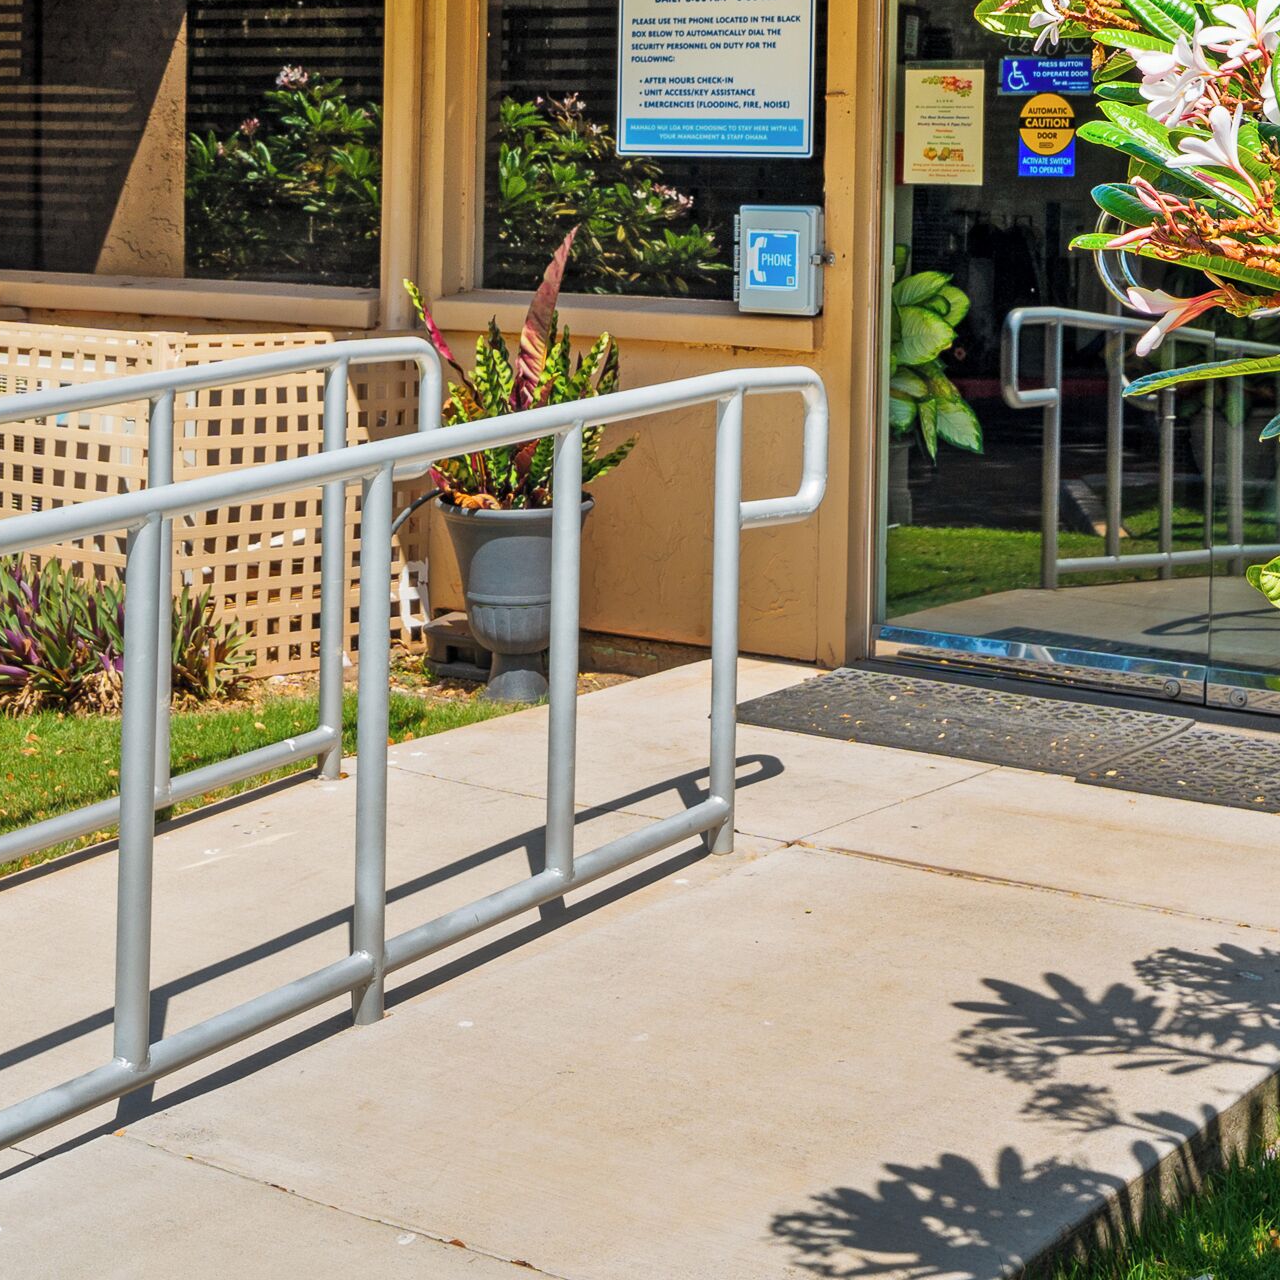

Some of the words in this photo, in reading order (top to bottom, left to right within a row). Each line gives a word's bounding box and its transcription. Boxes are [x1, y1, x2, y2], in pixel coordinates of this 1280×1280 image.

[658, 17, 671, 25] USE
[716, 16, 749, 24] LOCATED
[777, 15, 801, 23] BLACK
[686, 29, 746, 37] AUTOMATICALLY
[666, 42, 708, 50] PERSONNEL
[696, 101, 741, 109] (FLOODING,
[743, 101, 762, 109] FIRE,
[763, 101, 790, 109] NOISE)
[1025, 118, 1069, 128] CAUTION
[1022, 157, 1048, 165] ACTIVATE
[1050, 157, 1072, 165] SWITCH
[1040, 166, 1064, 174] OPERATE
[761, 253, 792, 267] PHONE
